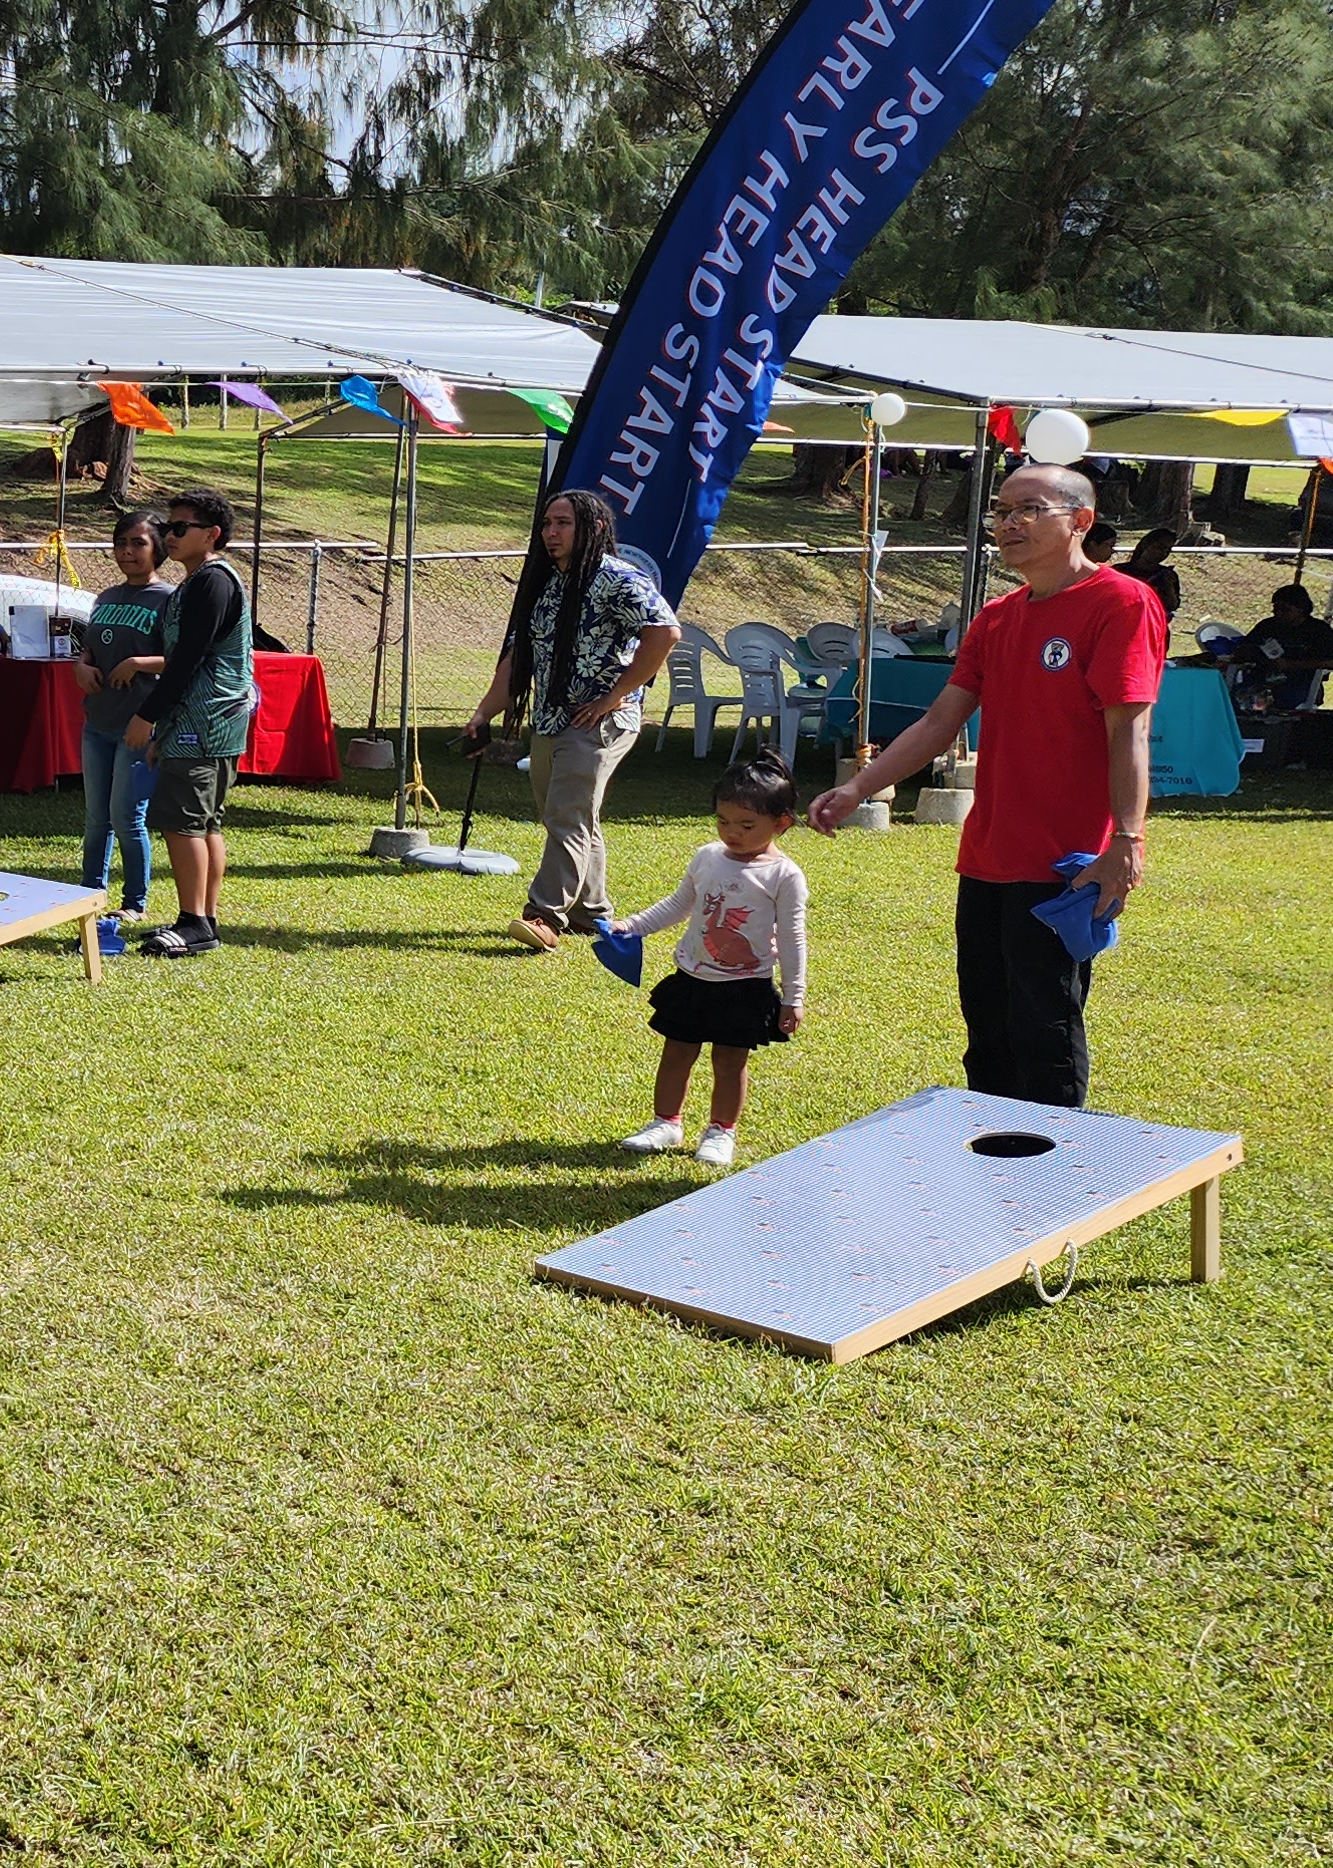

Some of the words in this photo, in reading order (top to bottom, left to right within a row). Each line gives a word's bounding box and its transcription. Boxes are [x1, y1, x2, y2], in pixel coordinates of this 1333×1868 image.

[850, 66, 945, 174] PSS
[688, 149, 789, 318] HEAD
[767, 167, 865, 314] HEAD
[599, 323, 700, 516] START
[687, 313, 773, 483] START
